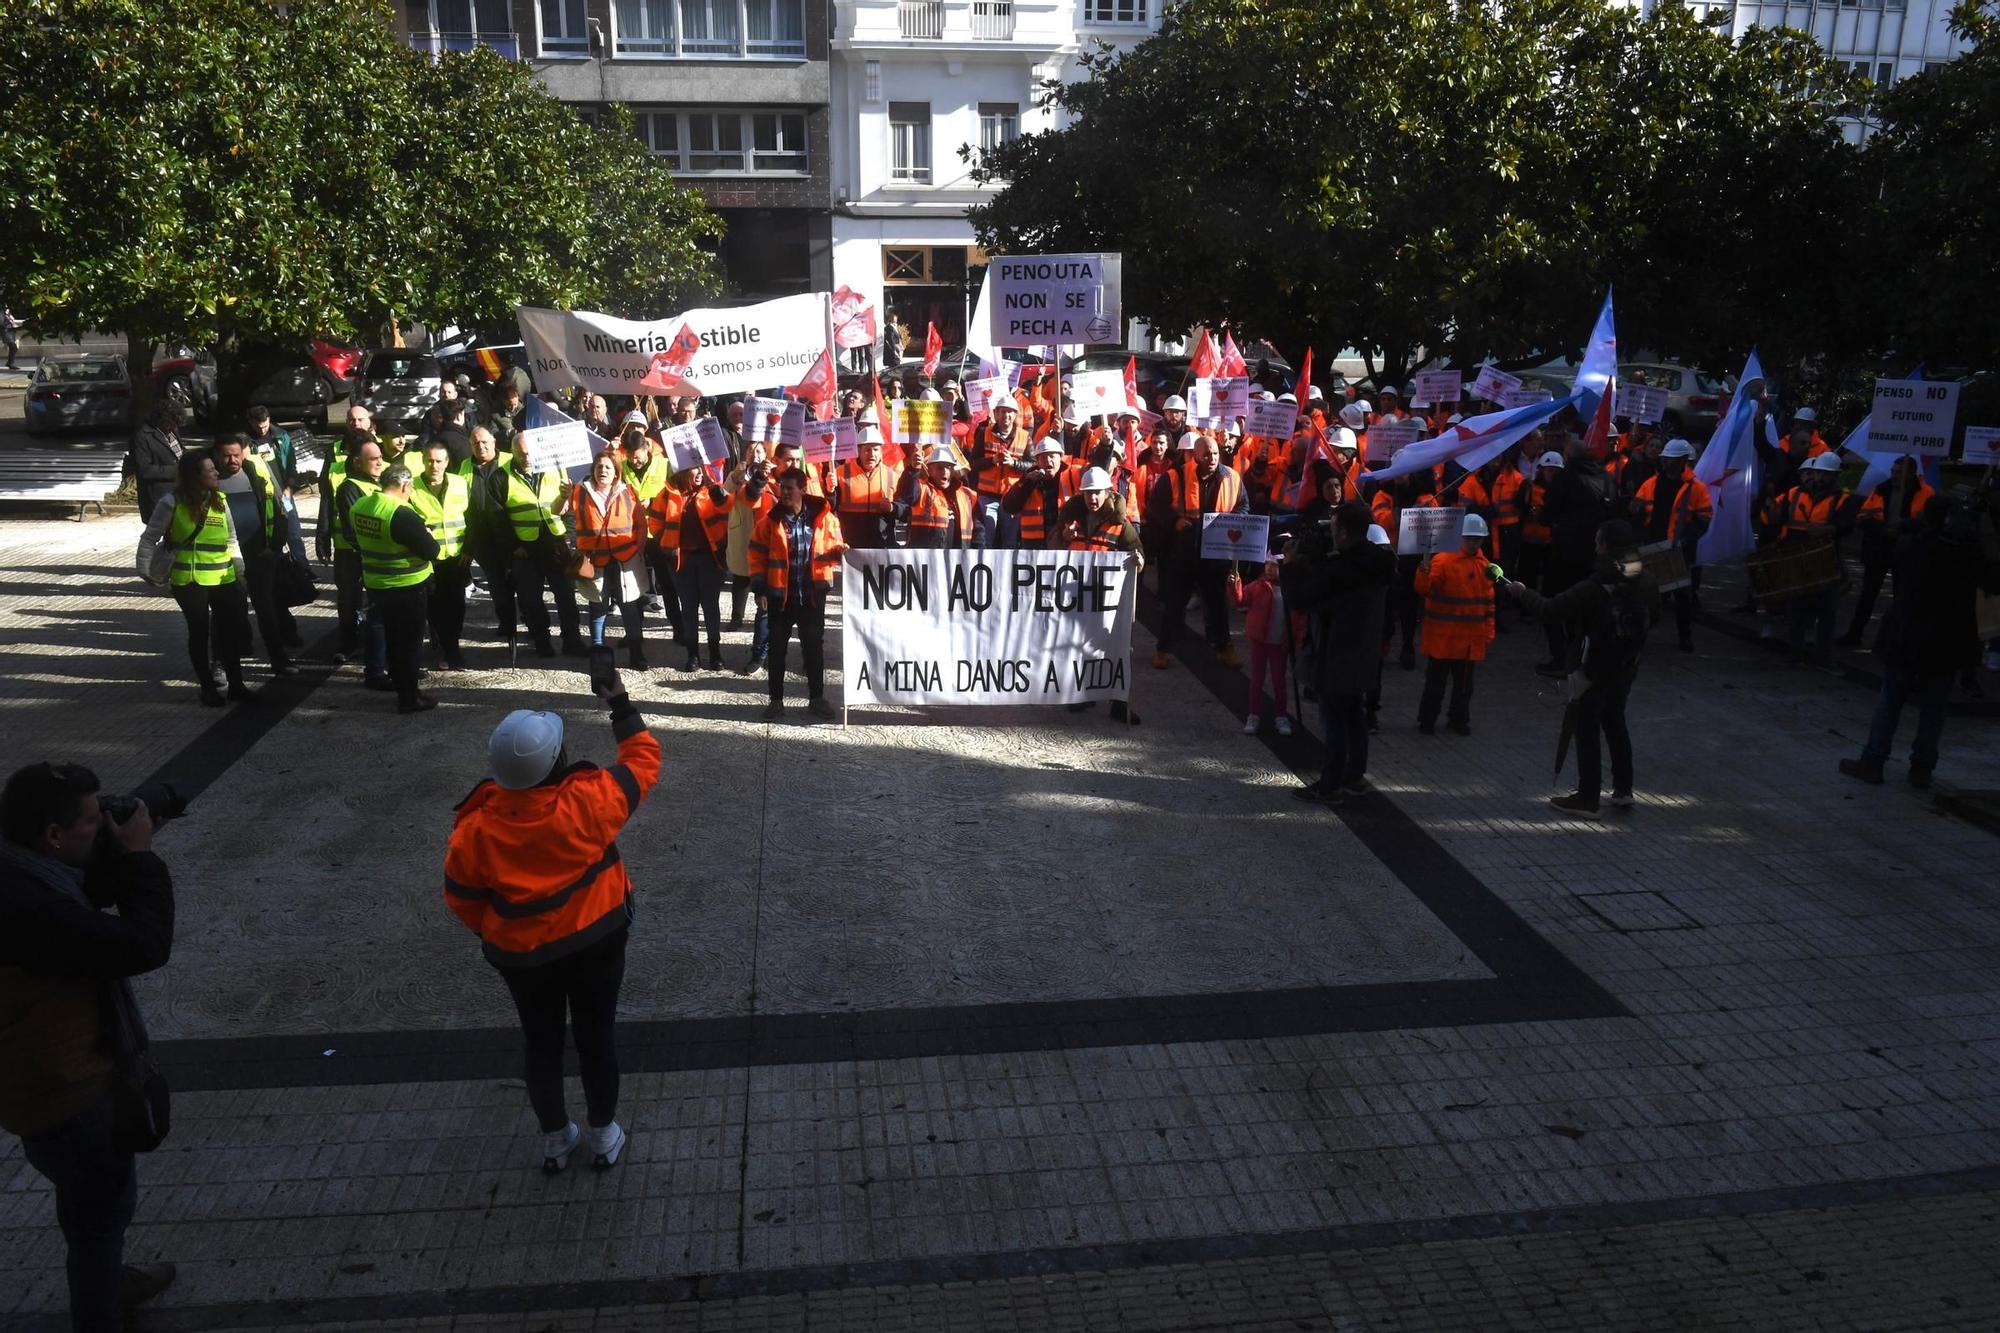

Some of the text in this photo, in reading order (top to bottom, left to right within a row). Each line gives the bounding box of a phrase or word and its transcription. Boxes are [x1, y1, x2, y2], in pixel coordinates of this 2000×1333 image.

[1005, 292, 1086, 309] NON SE
[583, 323, 761, 354] Minería stible
[610, 368, 619, 378] o
[703, 360, 753, 379] somos
[757, 358, 765, 369] a
[1876, 386, 1946, 400] PENSO NO
[1891, 411, 1933, 422] FUTURO
[1912, 435, 1945, 448] PURO
[862, 562, 1121, 613] NON AO PECHE
[857, 658, 1125, 693] A MINA DANOS A VIDA
